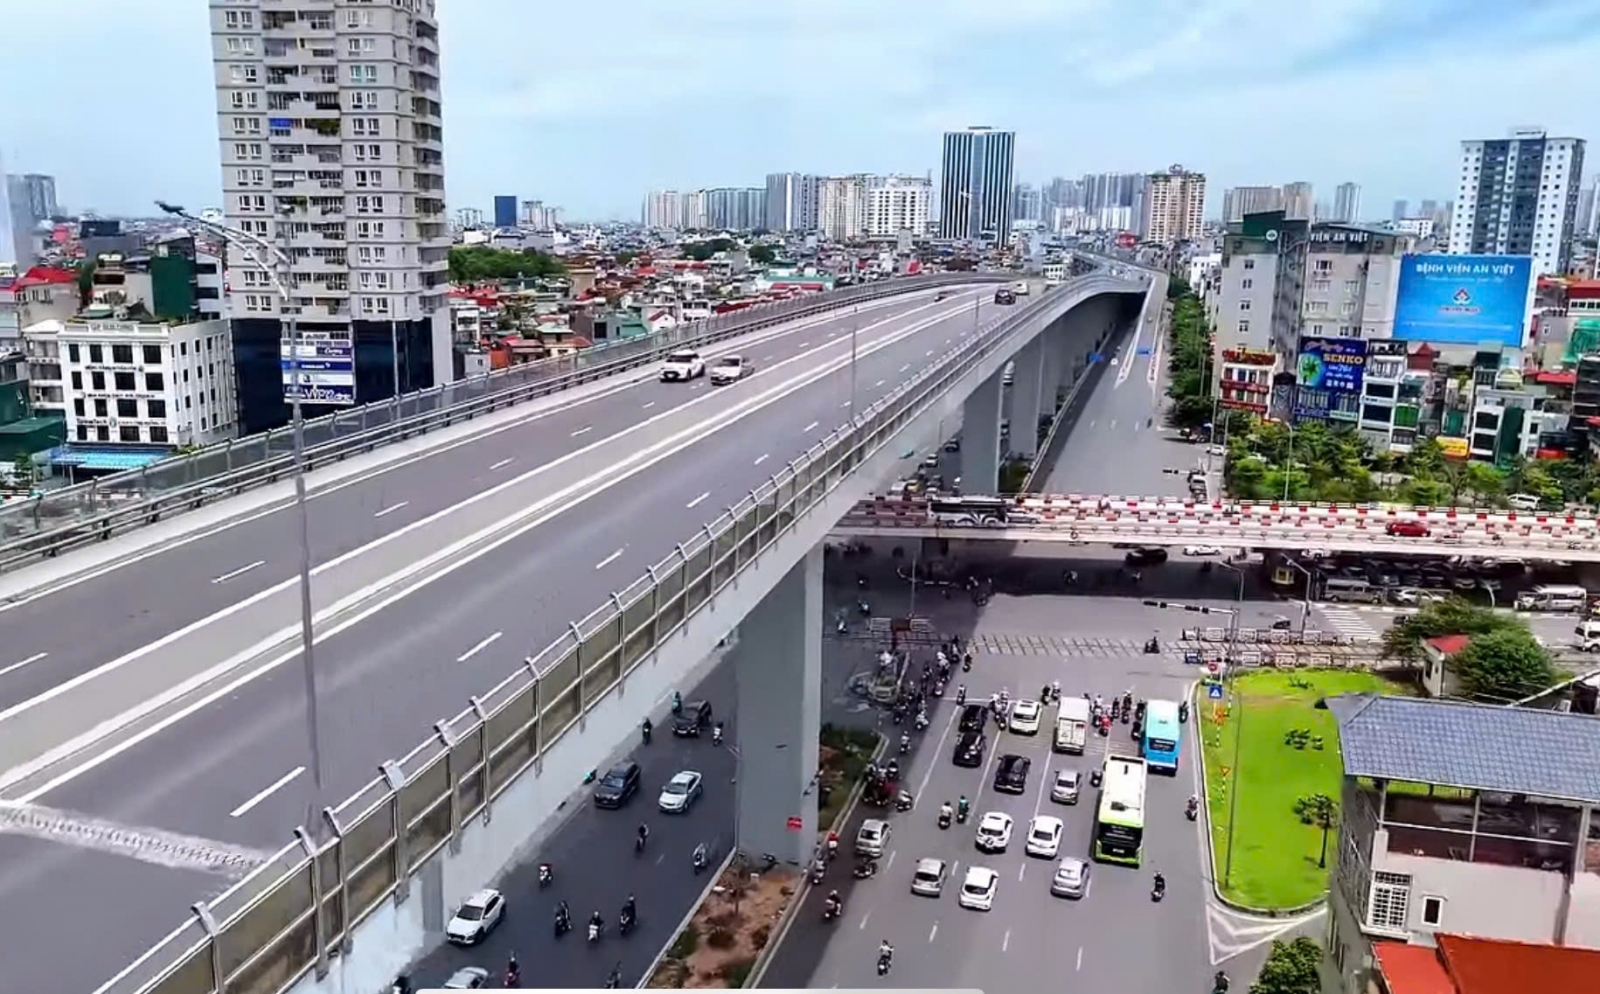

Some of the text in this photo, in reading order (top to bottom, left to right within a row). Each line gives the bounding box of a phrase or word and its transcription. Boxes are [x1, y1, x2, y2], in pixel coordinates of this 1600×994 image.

[1333, 232, 1345, 242] AN
[1416, 262, 1515, 275] BỆNH VIỆN AN VIỆT
[1323, 353, 1363, 364] SENKO
